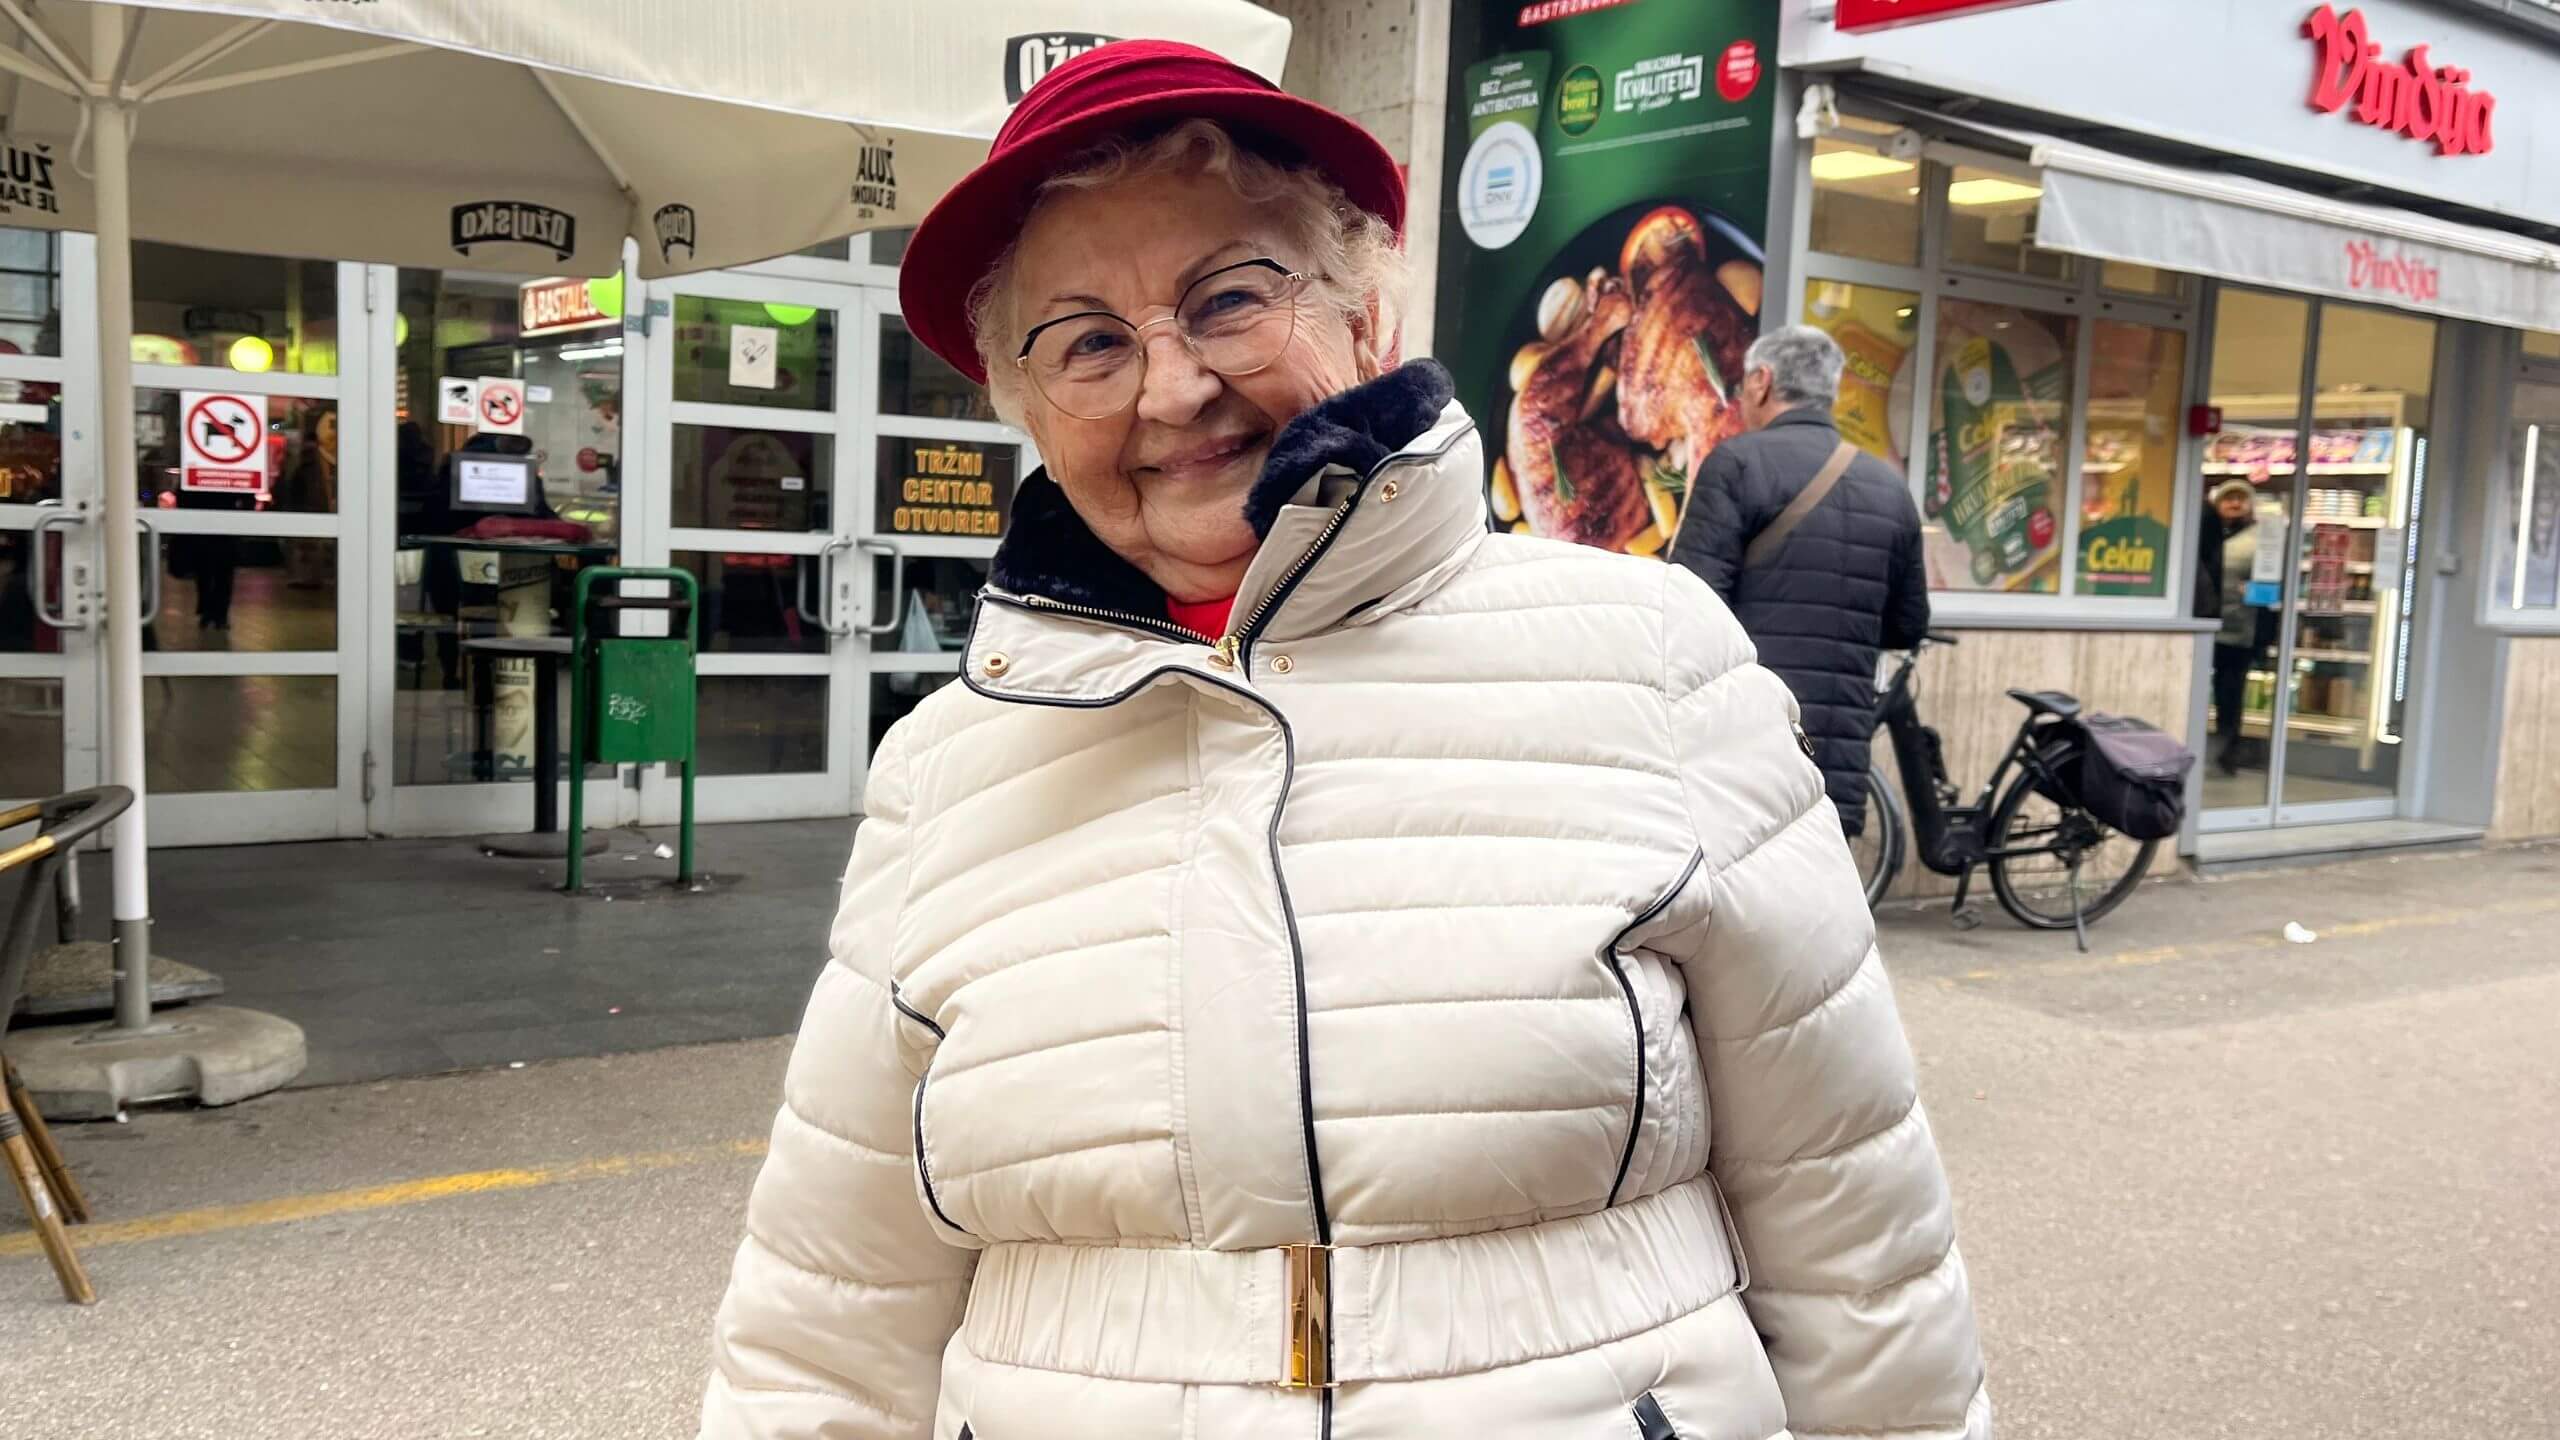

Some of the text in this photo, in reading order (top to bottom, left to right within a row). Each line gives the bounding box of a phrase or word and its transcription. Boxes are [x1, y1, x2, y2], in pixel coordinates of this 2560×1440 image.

[1622, 67, 1694, 102] KVALITETA
[2298, 2, 2496, 157] Vindija
[2346, 239, 2438, 303] Vindija
[914, 444, 983, 476] TRŽNI
[902, 477, 993, 506] CENTAR
[894, 506, 1000, 535] OTVOREN
[2088, 536, 2155, 572] Cekin
